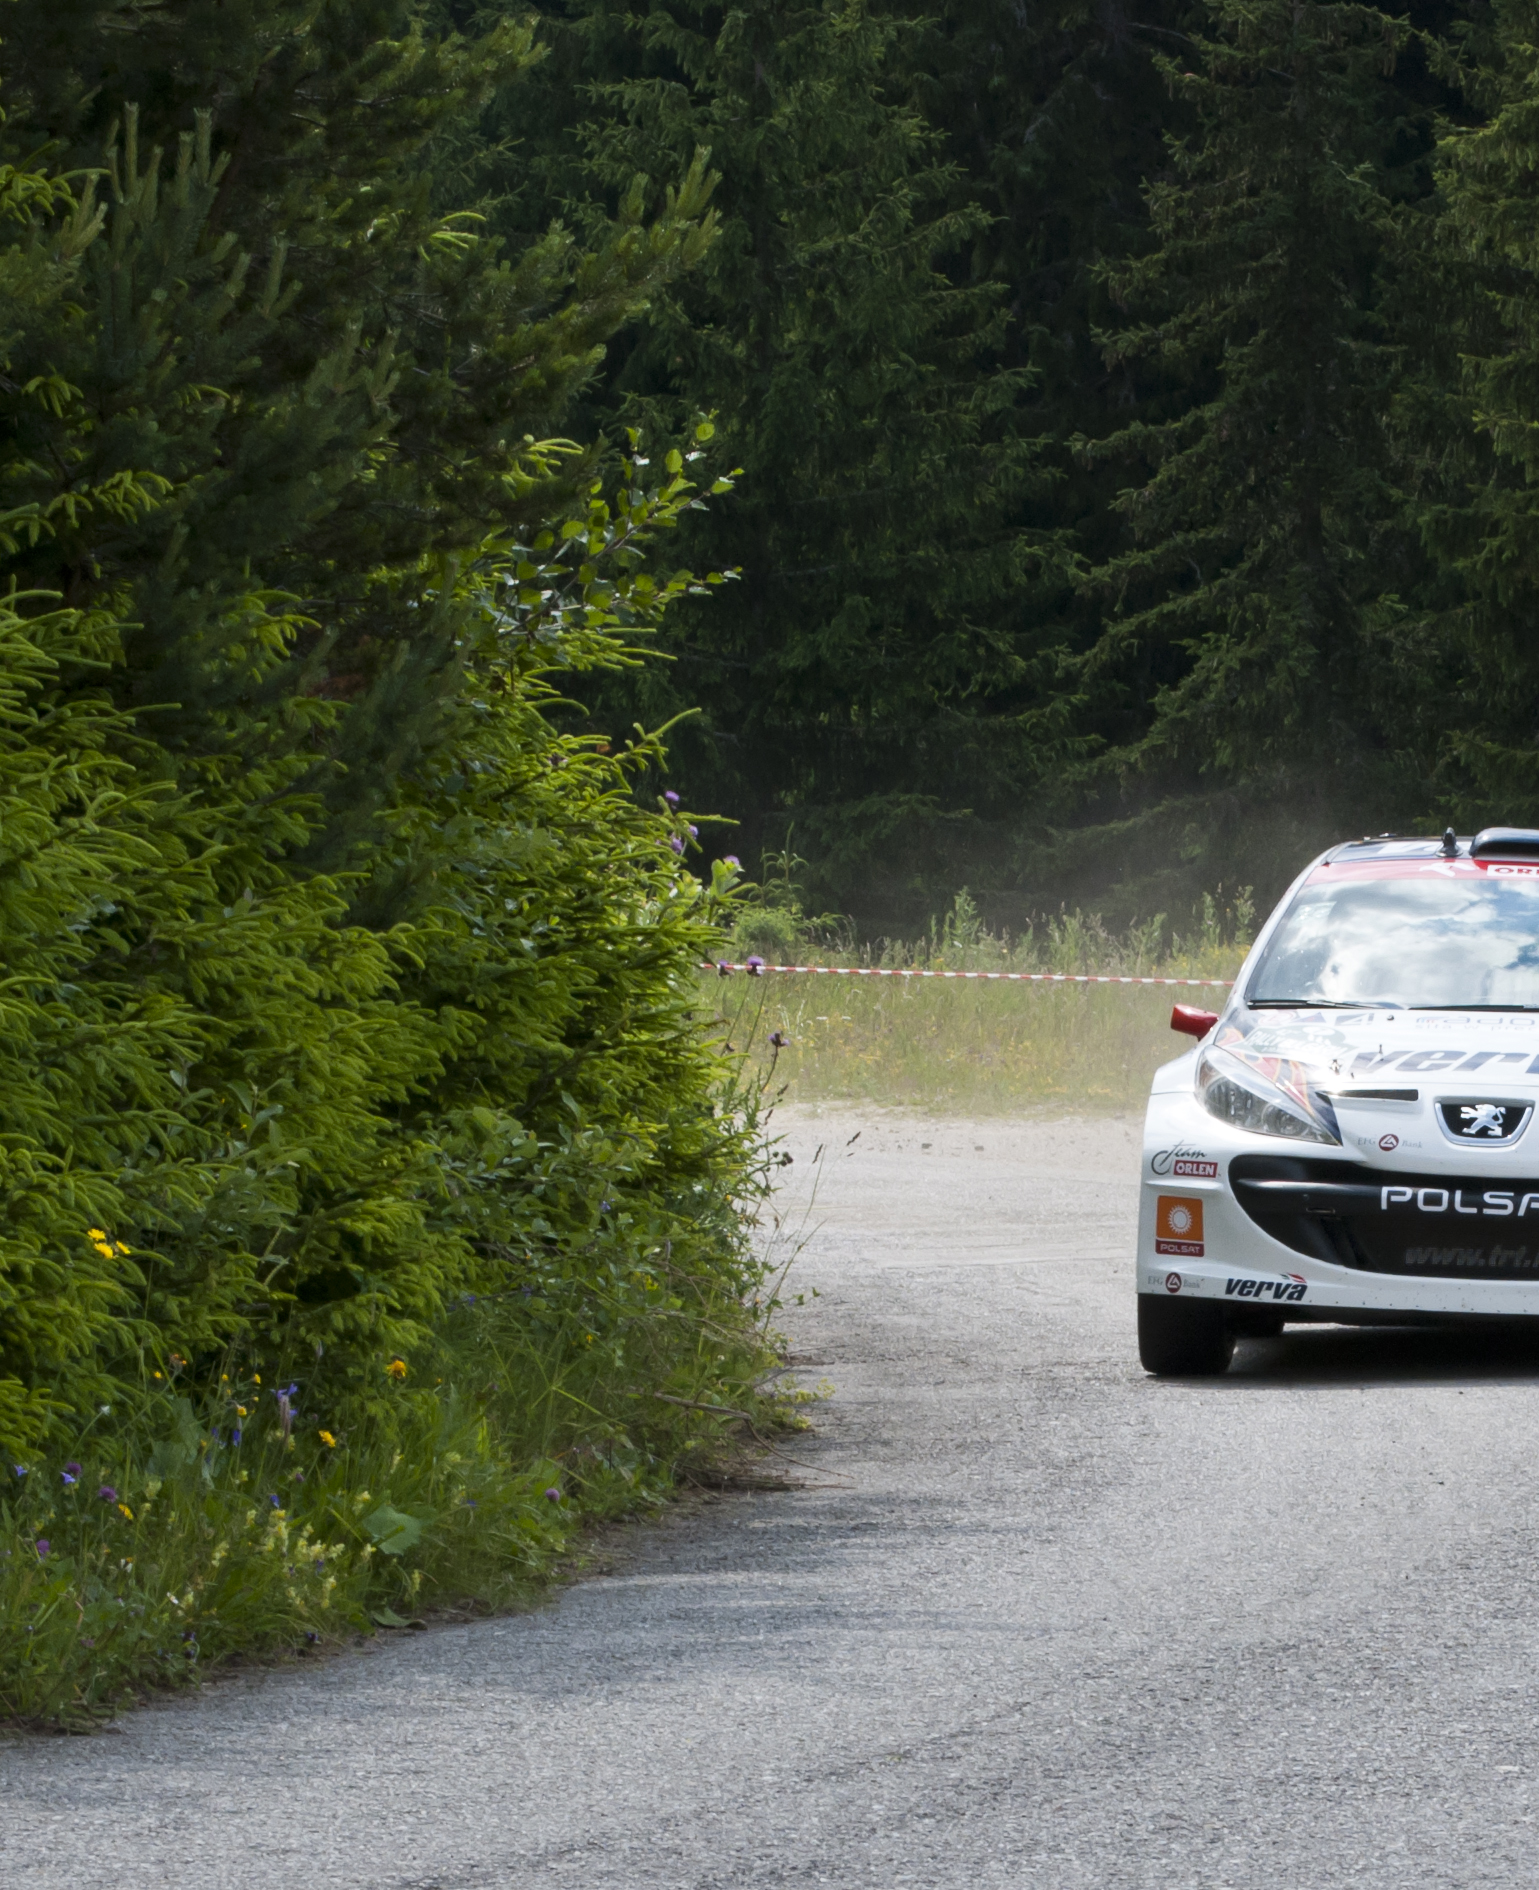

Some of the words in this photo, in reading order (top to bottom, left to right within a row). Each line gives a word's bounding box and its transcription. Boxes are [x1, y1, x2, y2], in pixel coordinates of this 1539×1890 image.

[1175, 1162, 1216, 1177] ORLEN
[1159, 1243, 1201, 1254] POLSAT
[1225, 1277, 1309, 1301] verva
